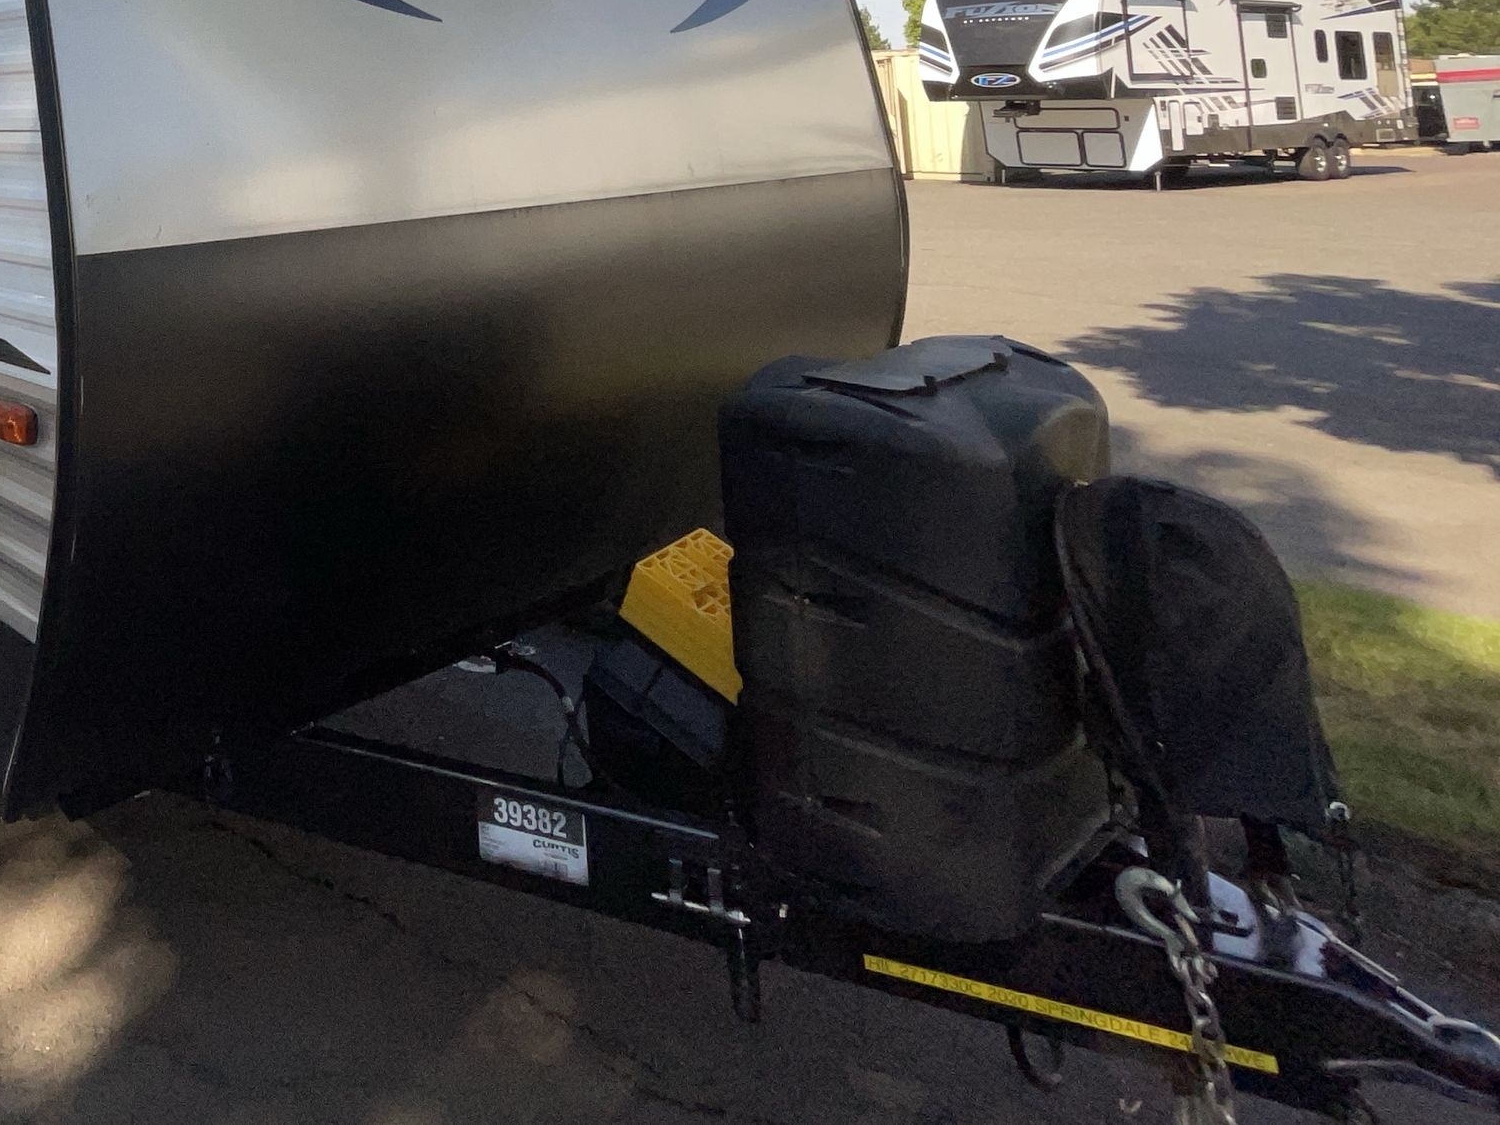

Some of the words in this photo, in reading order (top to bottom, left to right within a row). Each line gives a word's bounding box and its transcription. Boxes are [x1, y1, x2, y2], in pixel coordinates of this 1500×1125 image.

[493, 797, 568, 839] 39382
[532, 838, 581, 859] CURTIS
[1034, 999, 1162, 1041] SPRINGDALE
